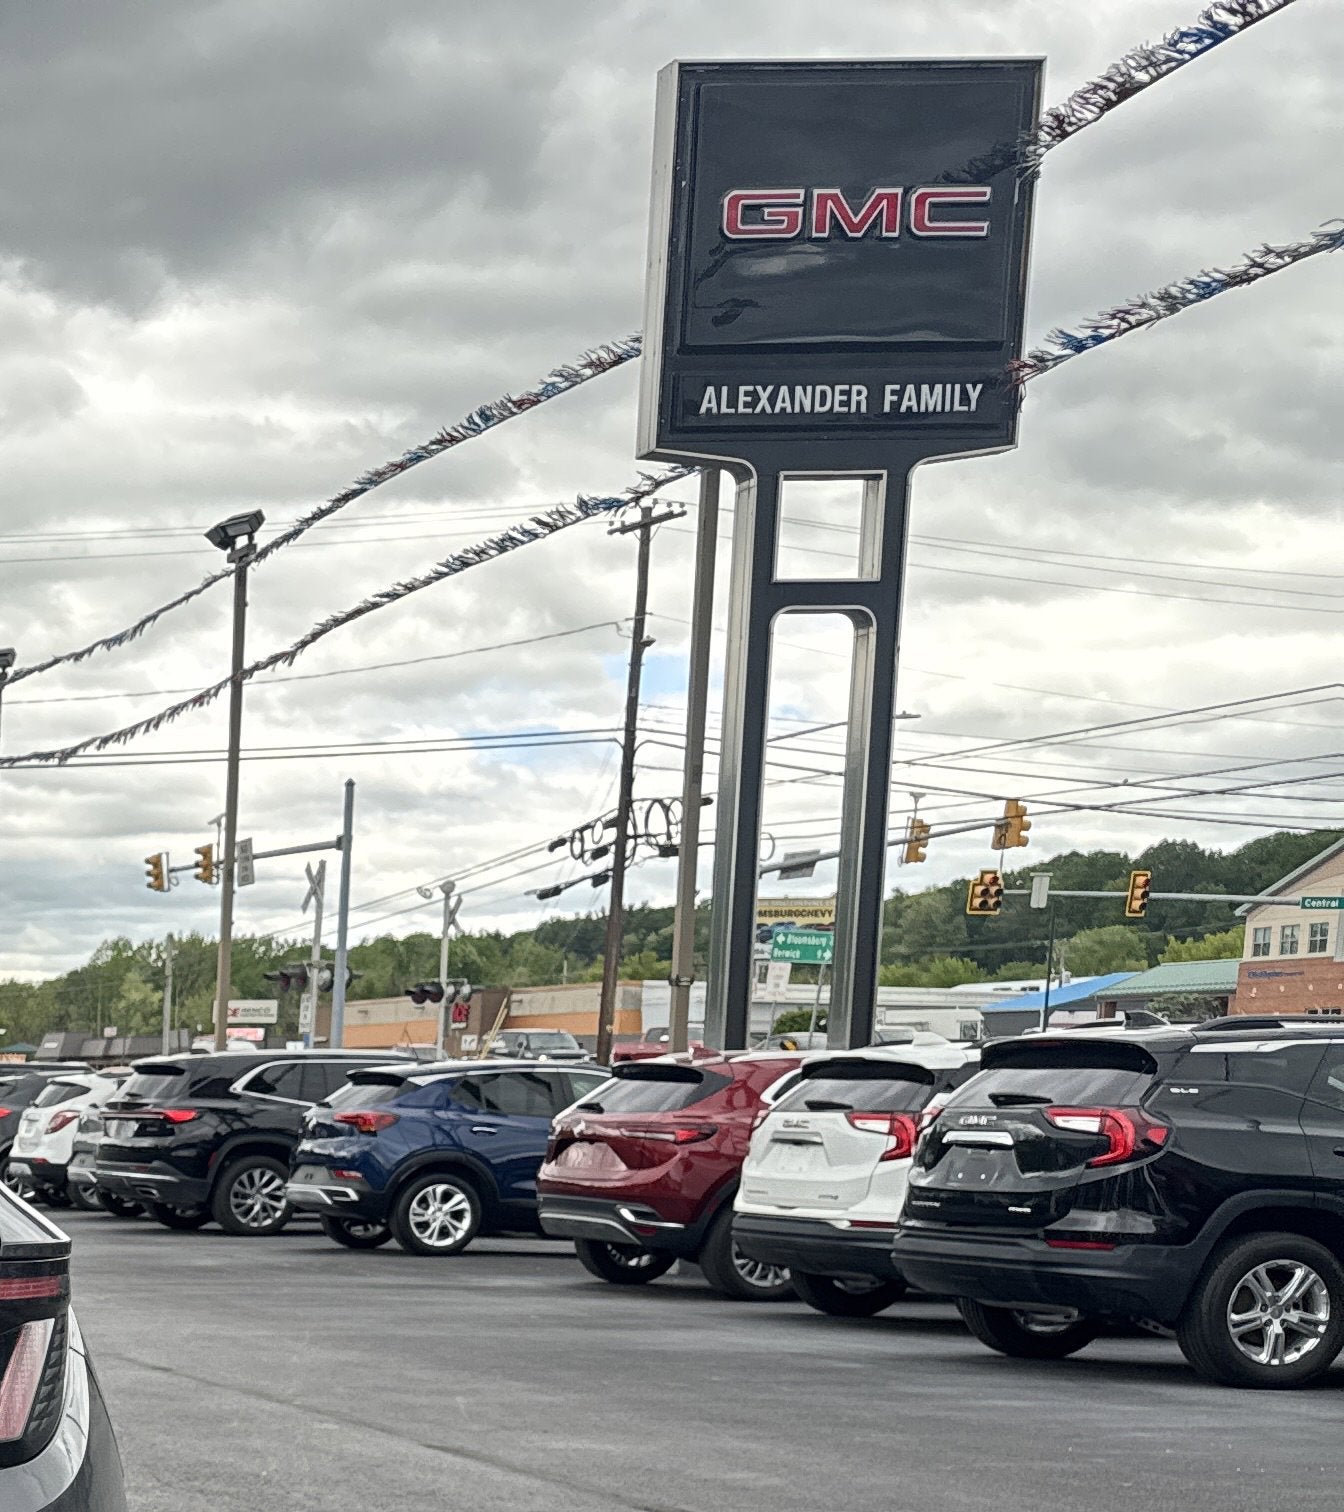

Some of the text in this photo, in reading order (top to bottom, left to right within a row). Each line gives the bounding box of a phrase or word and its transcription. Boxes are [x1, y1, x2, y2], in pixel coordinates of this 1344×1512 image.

[722, 186, 992, 239] GMC
[698, 383, 983, 415] ALEXANDER FAMILY
[1304, 898, 1339, 908] Central
